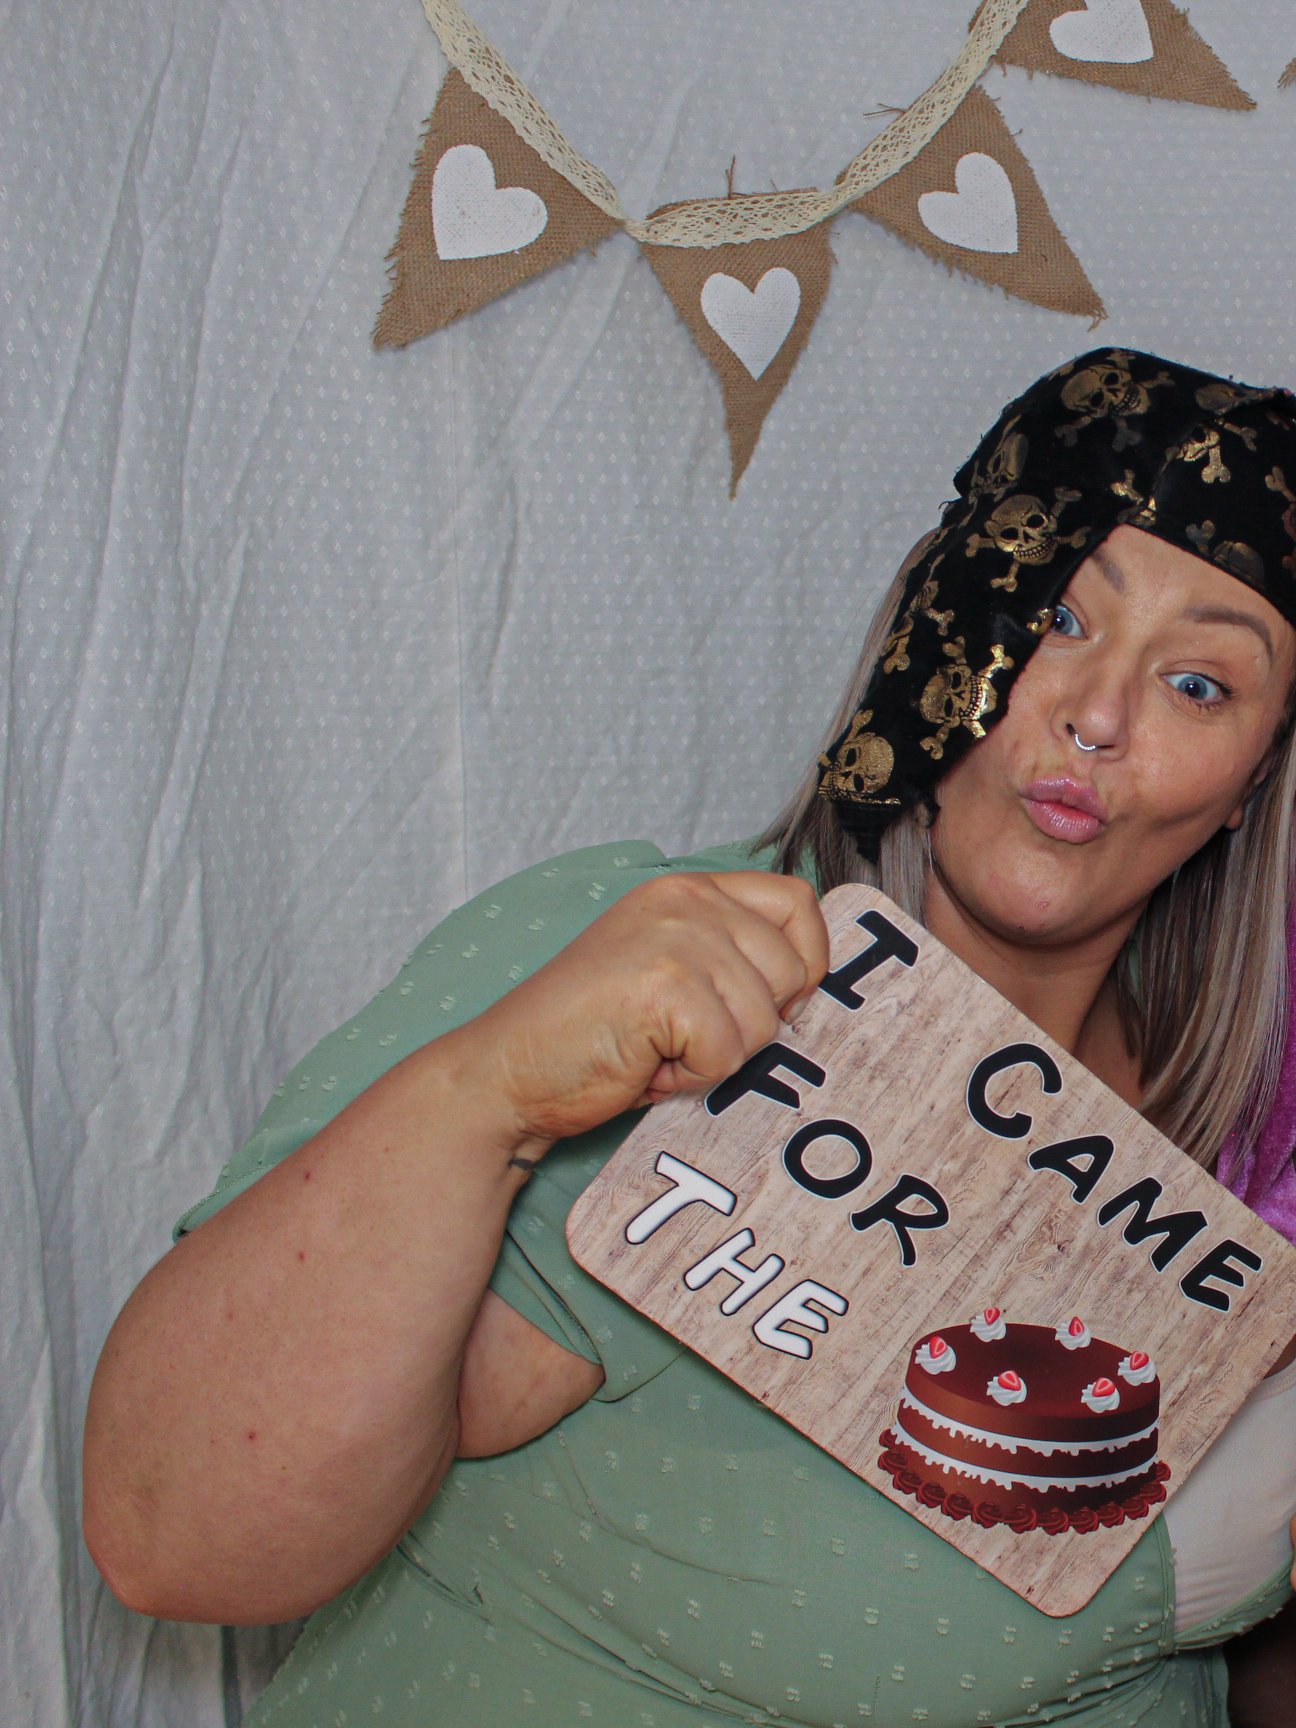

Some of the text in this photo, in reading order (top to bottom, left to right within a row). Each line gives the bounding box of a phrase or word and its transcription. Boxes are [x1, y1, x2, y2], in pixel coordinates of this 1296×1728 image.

[704, 1041, 950, 1267] FOR
[817, 909, 1263, 1312] I CAME
[624, 1150, 850, 1360] THE
